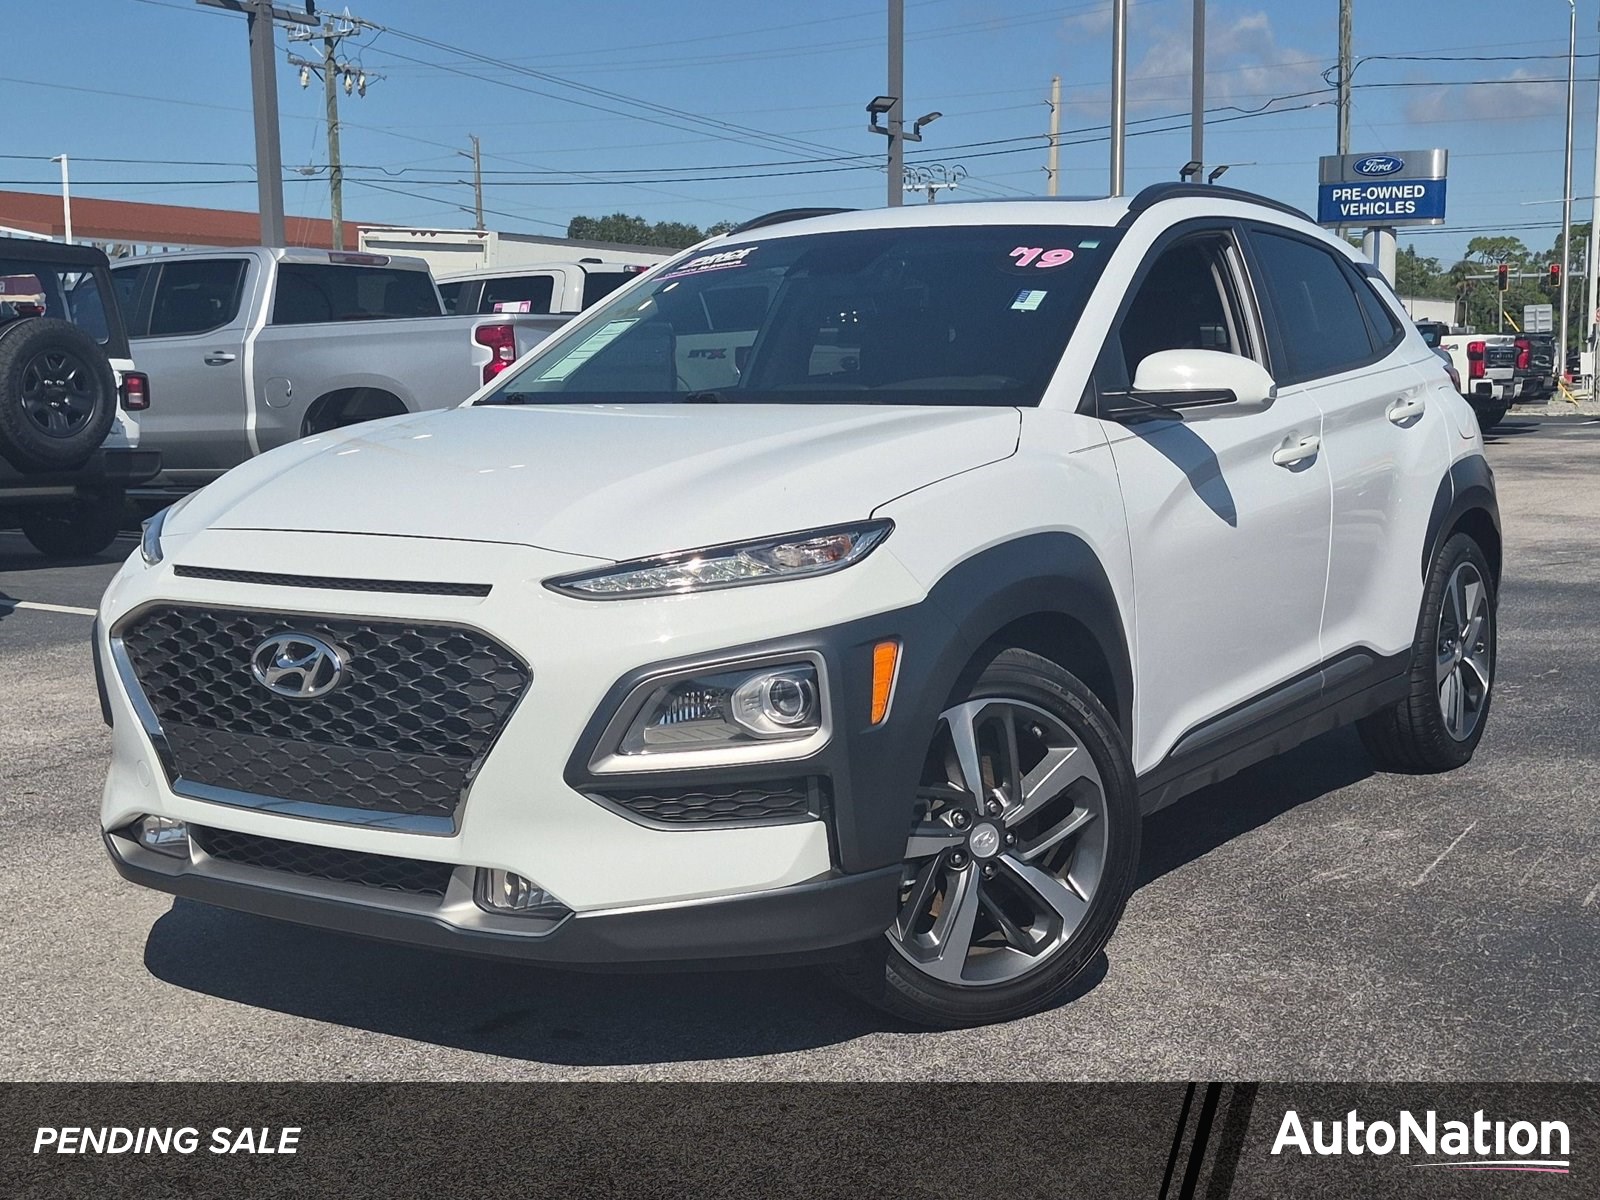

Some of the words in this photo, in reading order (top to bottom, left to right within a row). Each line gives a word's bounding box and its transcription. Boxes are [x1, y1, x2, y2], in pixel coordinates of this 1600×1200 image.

[1362, 158, 1395, 173] Ford
[1332, 185, 1425, 201] PRE-OWNED
[1340, 200, 1416, 216] VEHICLES
